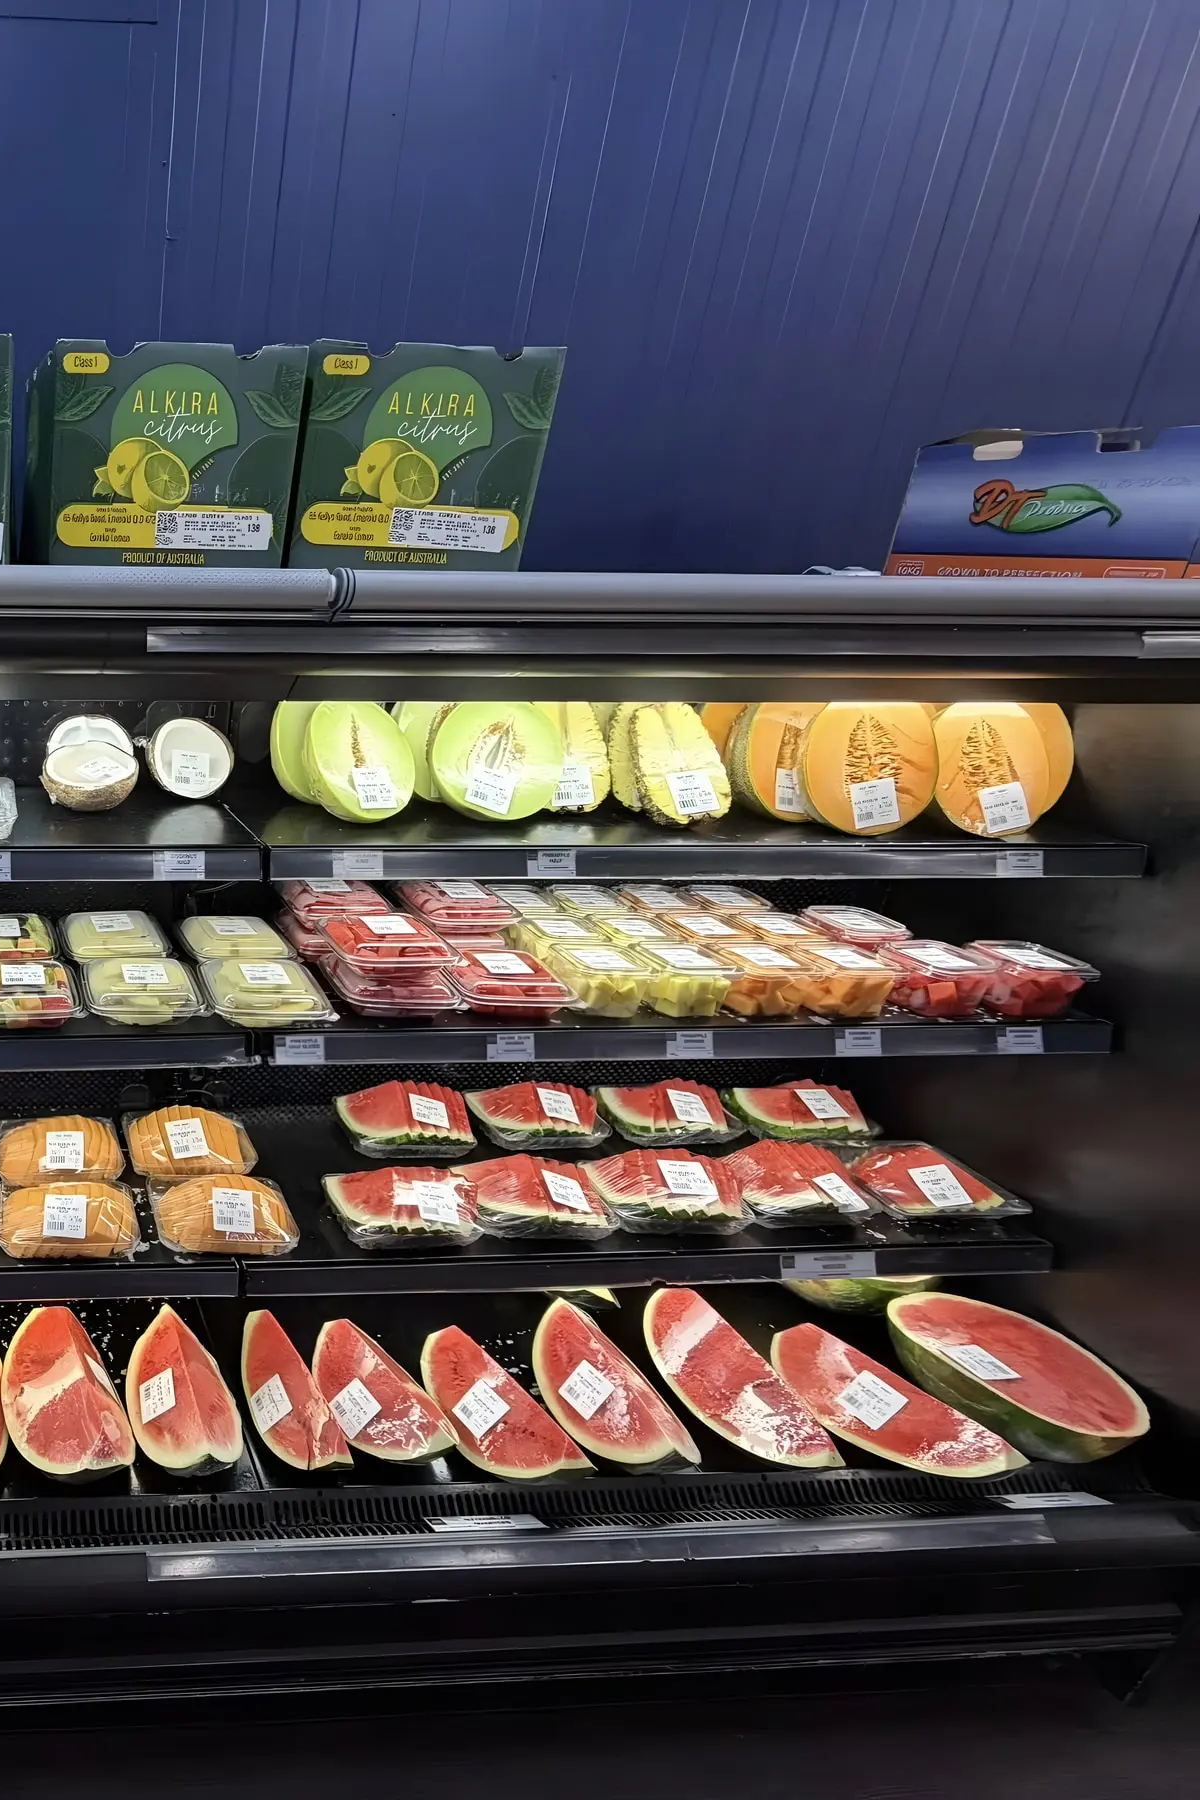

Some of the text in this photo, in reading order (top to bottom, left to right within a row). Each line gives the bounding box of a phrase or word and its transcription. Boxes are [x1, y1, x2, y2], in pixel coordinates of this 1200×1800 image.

[73, 356, 93, 368] Class
[334, 358, 353, 369] Class
[132, 390, 219, 415] ALKIRA
[388, 392, 475, 417] ALKIRA
[143, 407, 222, 443] citrus
[397, 408, 477, 444] citrus
[247, 524, 260, 532] 138
[483, 526, 496, 534] 138
[122, 552, 205, 564] PRODUCT OF AUSTRALIA
[364, 550, 447, 564] PRODUCT OF AUSTRALIA
